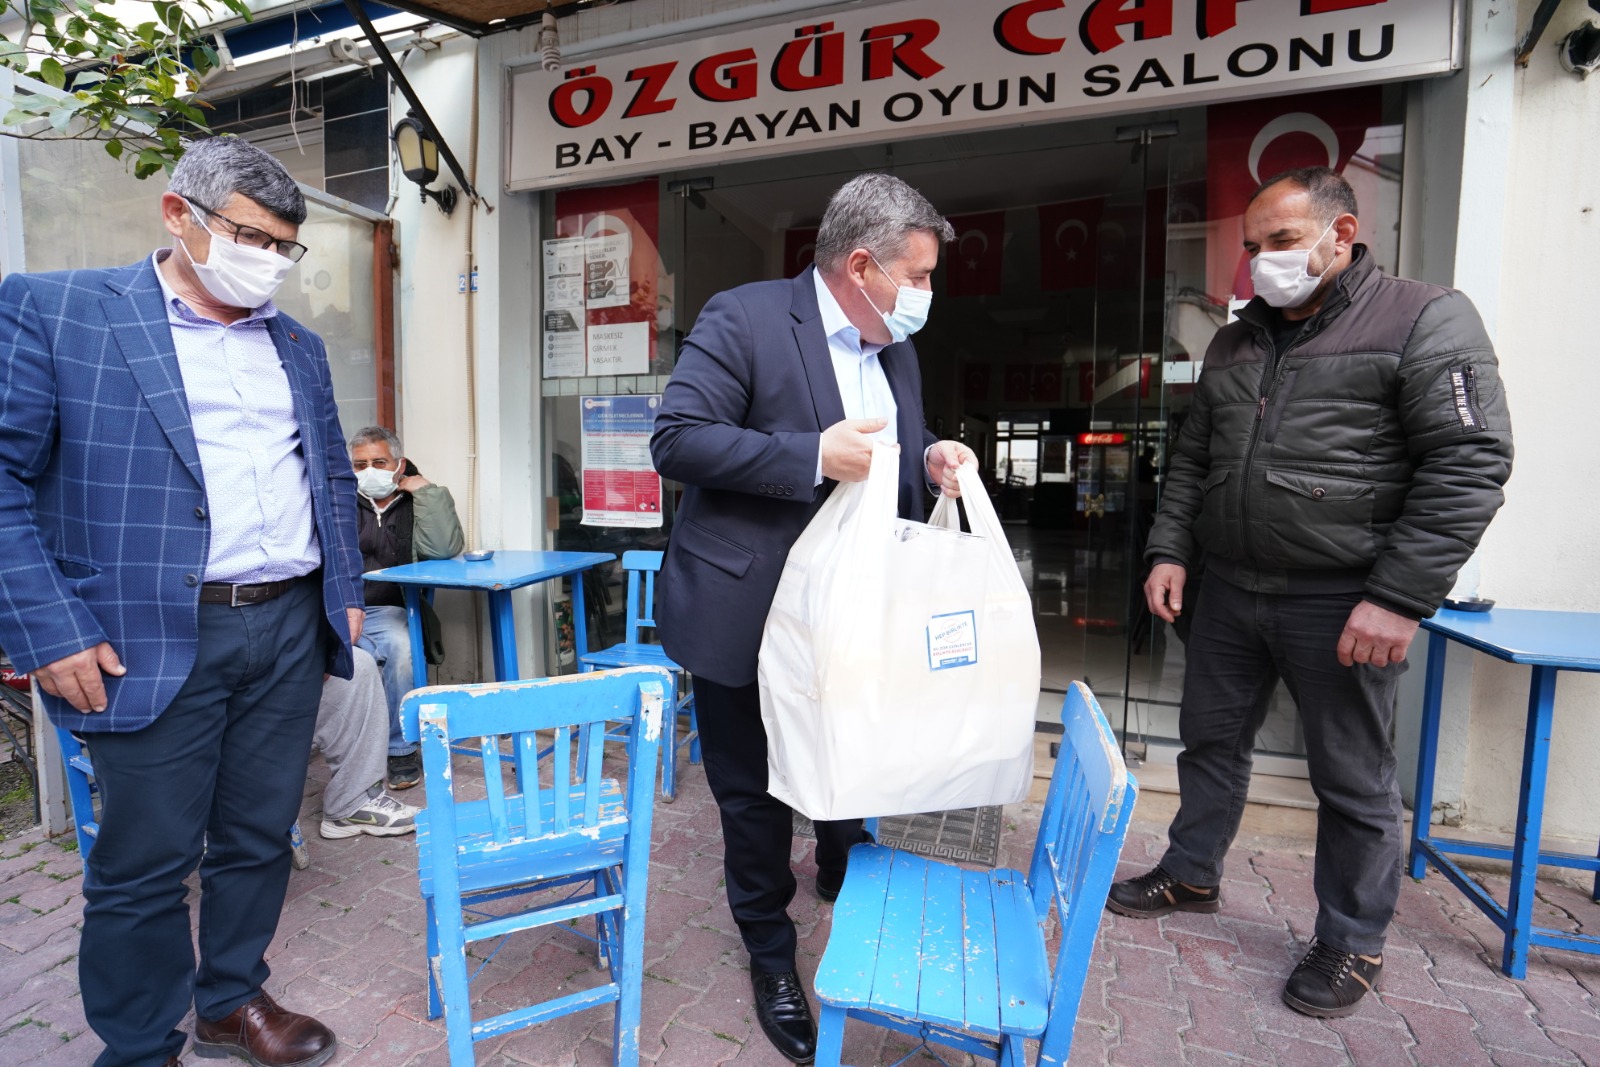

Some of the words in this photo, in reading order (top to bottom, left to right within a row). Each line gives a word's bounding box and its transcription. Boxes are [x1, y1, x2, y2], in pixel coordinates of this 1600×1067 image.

[548, 18, 946, 129] ÖZGÜR
[992, 0, 1388, 56] CA
[555, 132, 643, 170] BAY
[657, 139, 672, 149] -
[688, 100, 861, 151] BAYAN
[882, 71, 1057, 123] OYUN
[1082, 23, 1395, 98] SALONU
[592, 331, 624, 341] MASKESİZ
[592, 344, 618, 352] GİRMEK
[1452, 372, 1463, 386] BACK
[1456, 395, 1466, 406] THE
